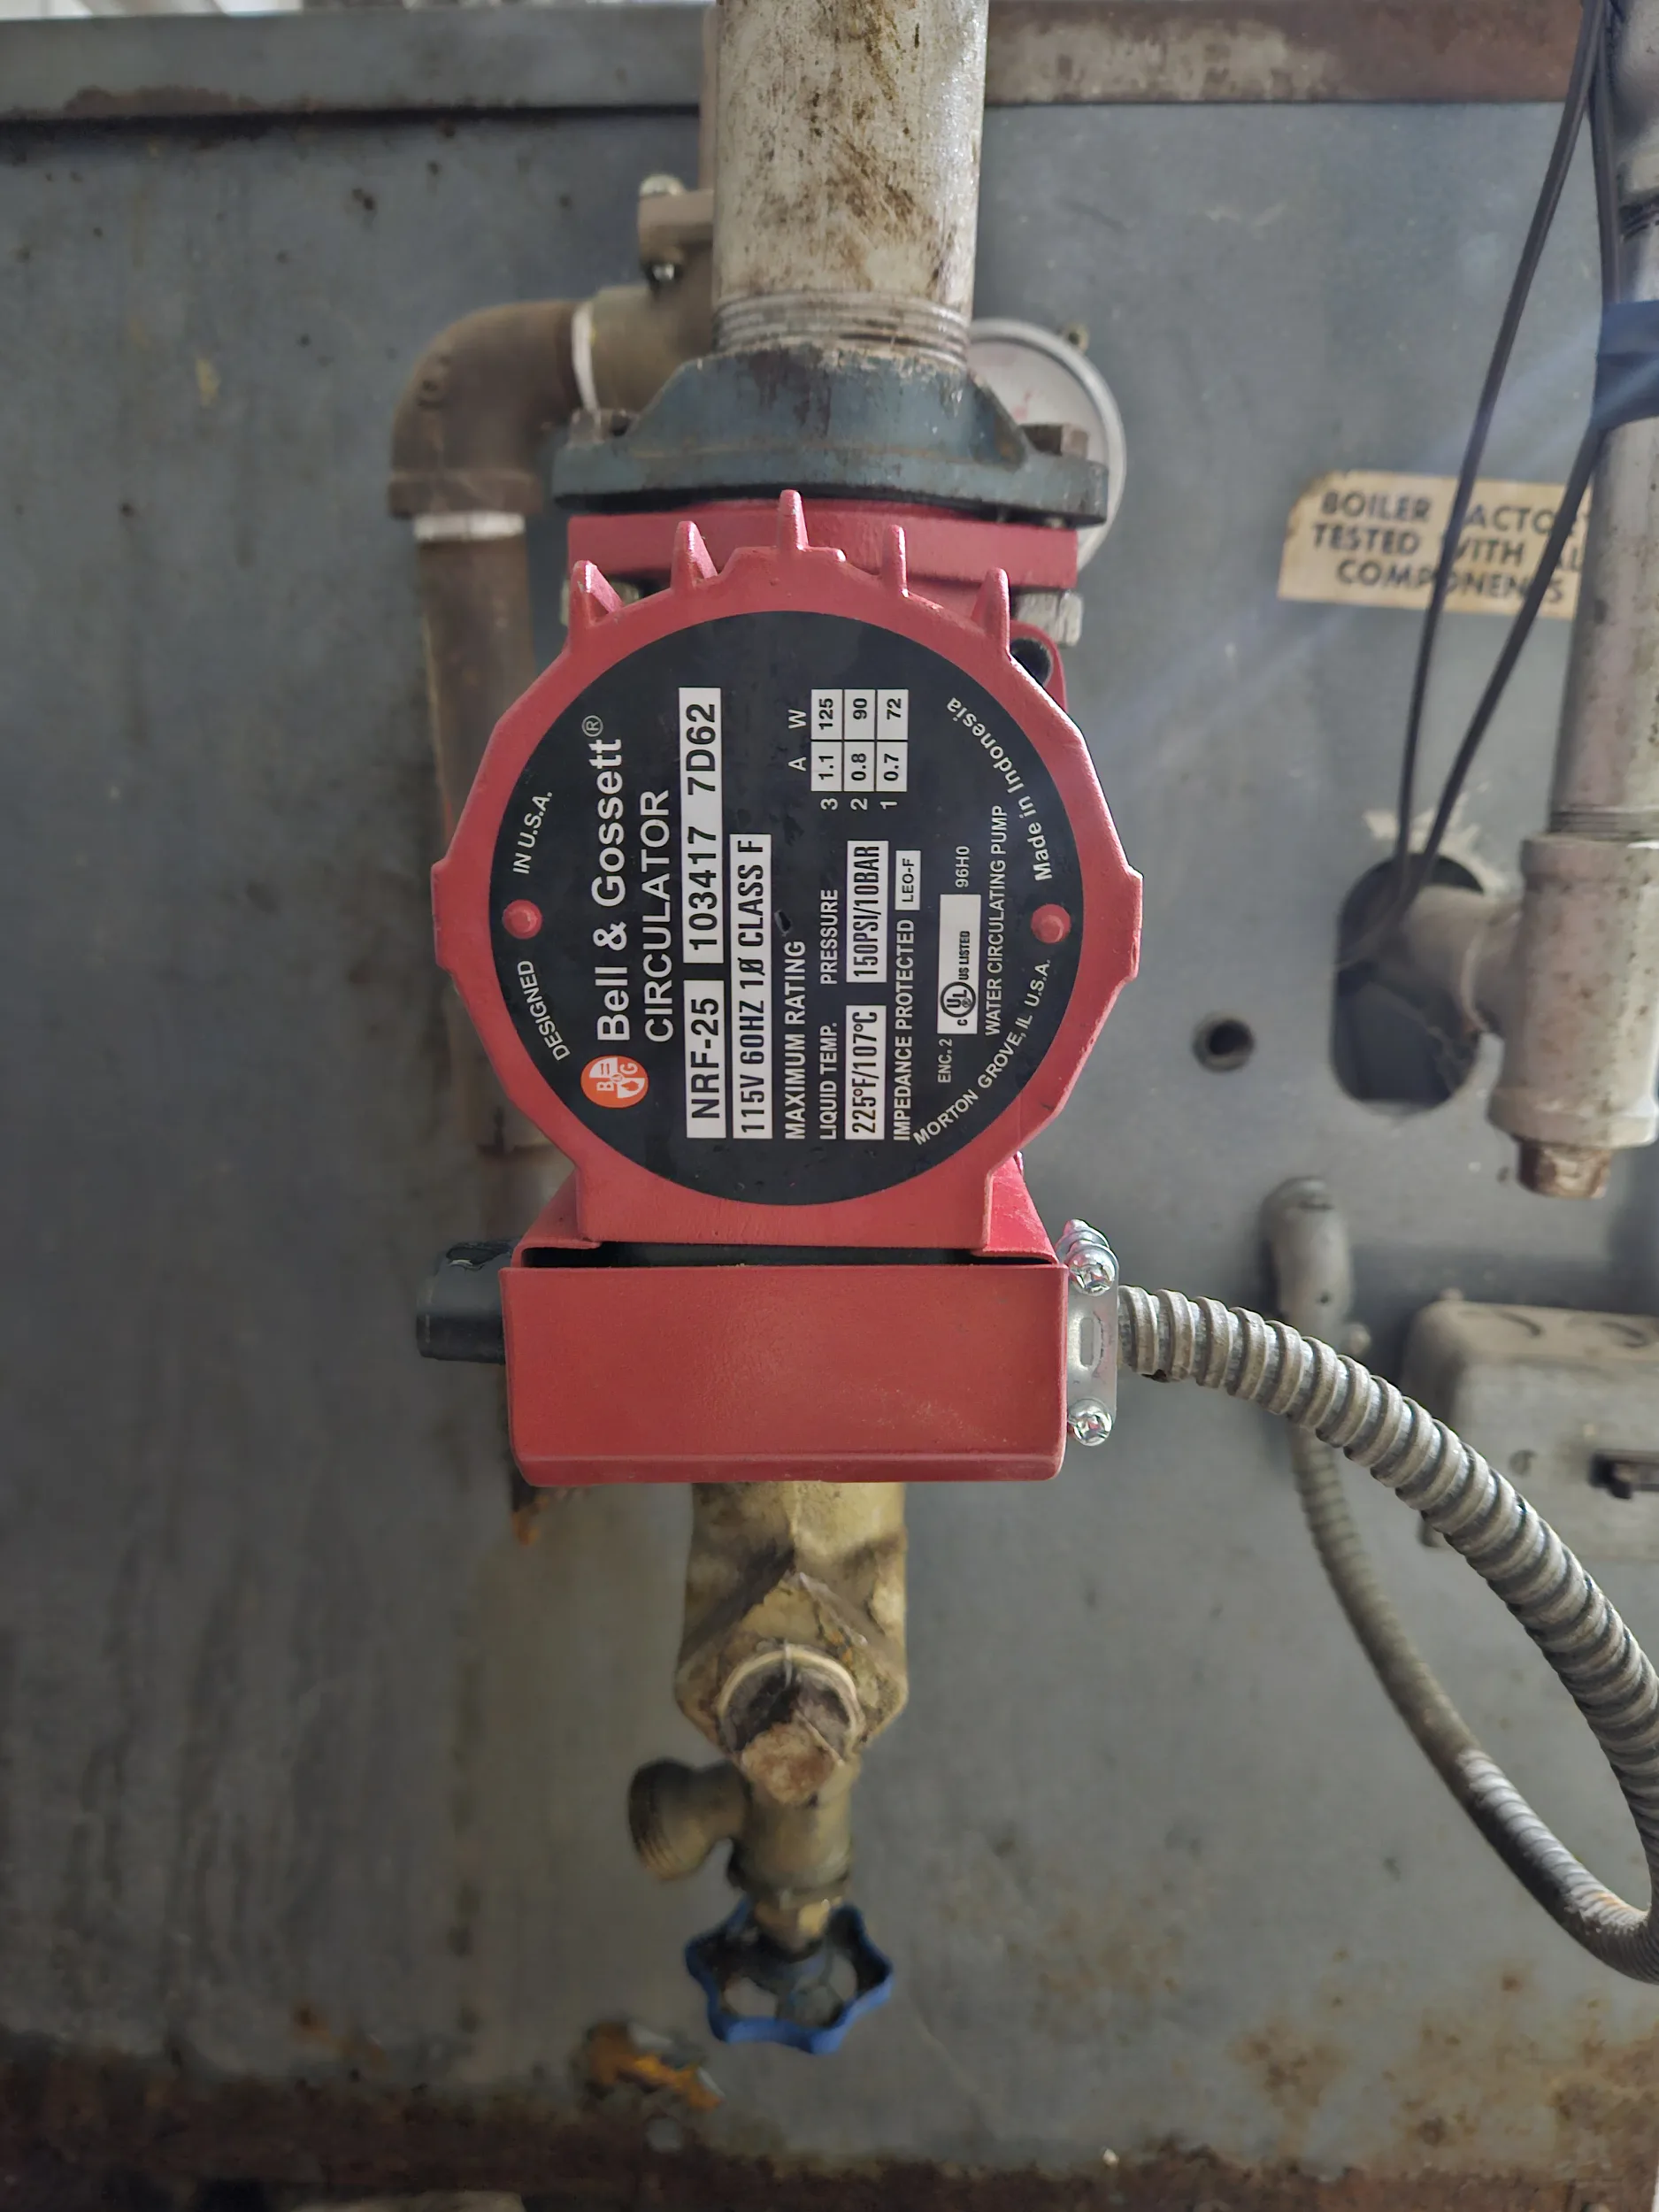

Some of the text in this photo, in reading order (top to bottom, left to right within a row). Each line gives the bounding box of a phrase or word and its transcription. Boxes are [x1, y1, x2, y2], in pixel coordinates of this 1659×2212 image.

[1312, 522, 1421, 557] TESTED
[1321, 490, 1588, 536] BOILER ACTO
[788, 710, 806, 772] A W
[818, 698, 838, 810] 3 1.1 125
[850, 698, 868, 810] 2 0.8 90
[880, 698, 902, 810] 1 0.7 72
[945, 697, 1052, 881] Made in Indonesia
[685, 703, 718, 950] 103417 7D62
[738, 841, 763, 853] F
[513, 791, 570, 1060] DESIGNED IN U.S.A.
[640, 790, 673, 1042] CIRCULATOR
[737, 864, 764, 947] CLASS
[852, 846, 881, 977] 150PSI/10BAR
[902, 858, 914, 902] LEO-F
[985, 805, 1008, 1035] WATER CIRCULATING PUMP
[593, 922, 626, 950] &
[820, 889, 838, 984] PRESSURE
[958, 967, 969, 979] US
[959, 931, 970, 964] LISTED
[595, 966, 630, 1041] Bell
[740, 1000, 764, 1065] 60HZ
[785, 941, 806, 1140] MAXIMUM RATING
[894, 919, 914, 1141] IMPEDANCE PROTECTED
[912, 959, 1050, 1145] MORTON GROVE, IL U.S.A.
[690, 998, 720, 1118] NRF-25
[740, 1074, 764, 1133] 115V
[819, 1023, 838, 1140] LIQUID TEMP.
[937, 1050, 952, 1083] ENC.
